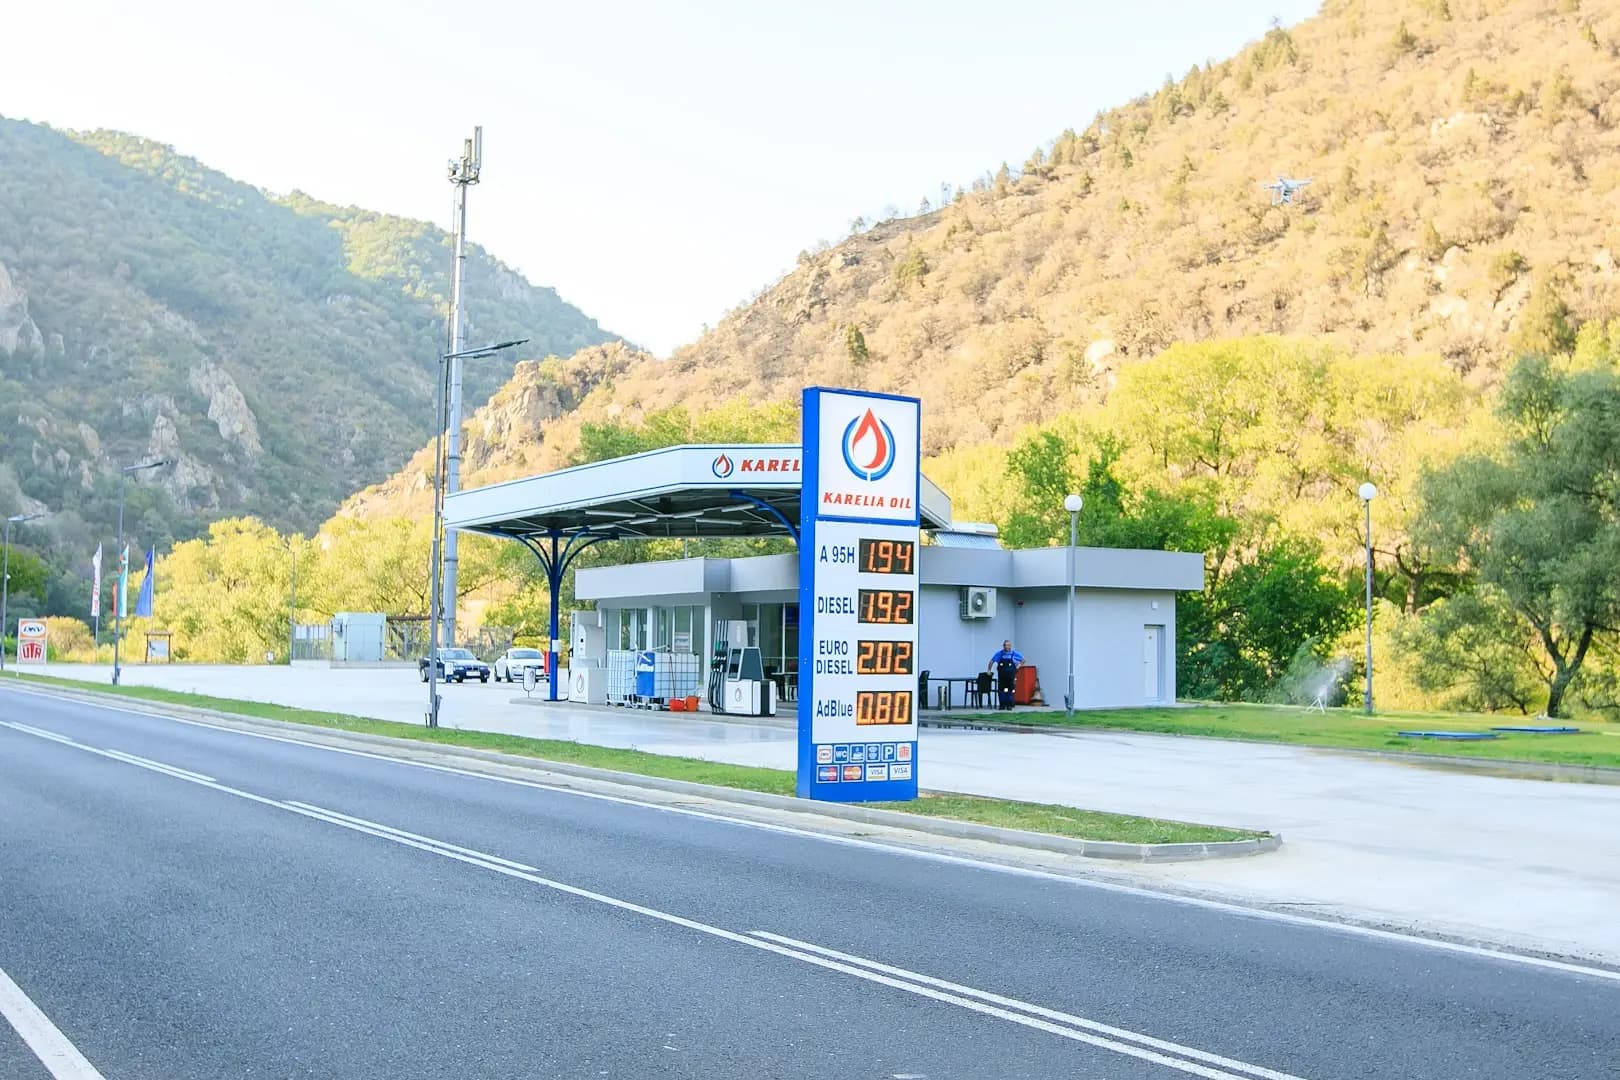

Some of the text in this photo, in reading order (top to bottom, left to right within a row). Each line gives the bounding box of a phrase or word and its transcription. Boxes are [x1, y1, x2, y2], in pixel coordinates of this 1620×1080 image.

[741, 459, 801, 472] KAREL
[823, 491, 912, 509] KARELIA OIL
[820, 545, 855, 564] A 95H
[867, 541, 912, 573] 1.94
[818, 596, 855, 615] DIESEL
[866, 592, 912, 623] 1.92
[819, 640, 848, 655] EURO
[816, 659, 853, 675] DIESEL
[858, 641, 911, 674] 2.02
[816, 699, 853, 718] AdBlue
[856, 692, 911, 725] 0.80
[835, 750, 847, 758] WC
[884, 746, 893, 759] P
